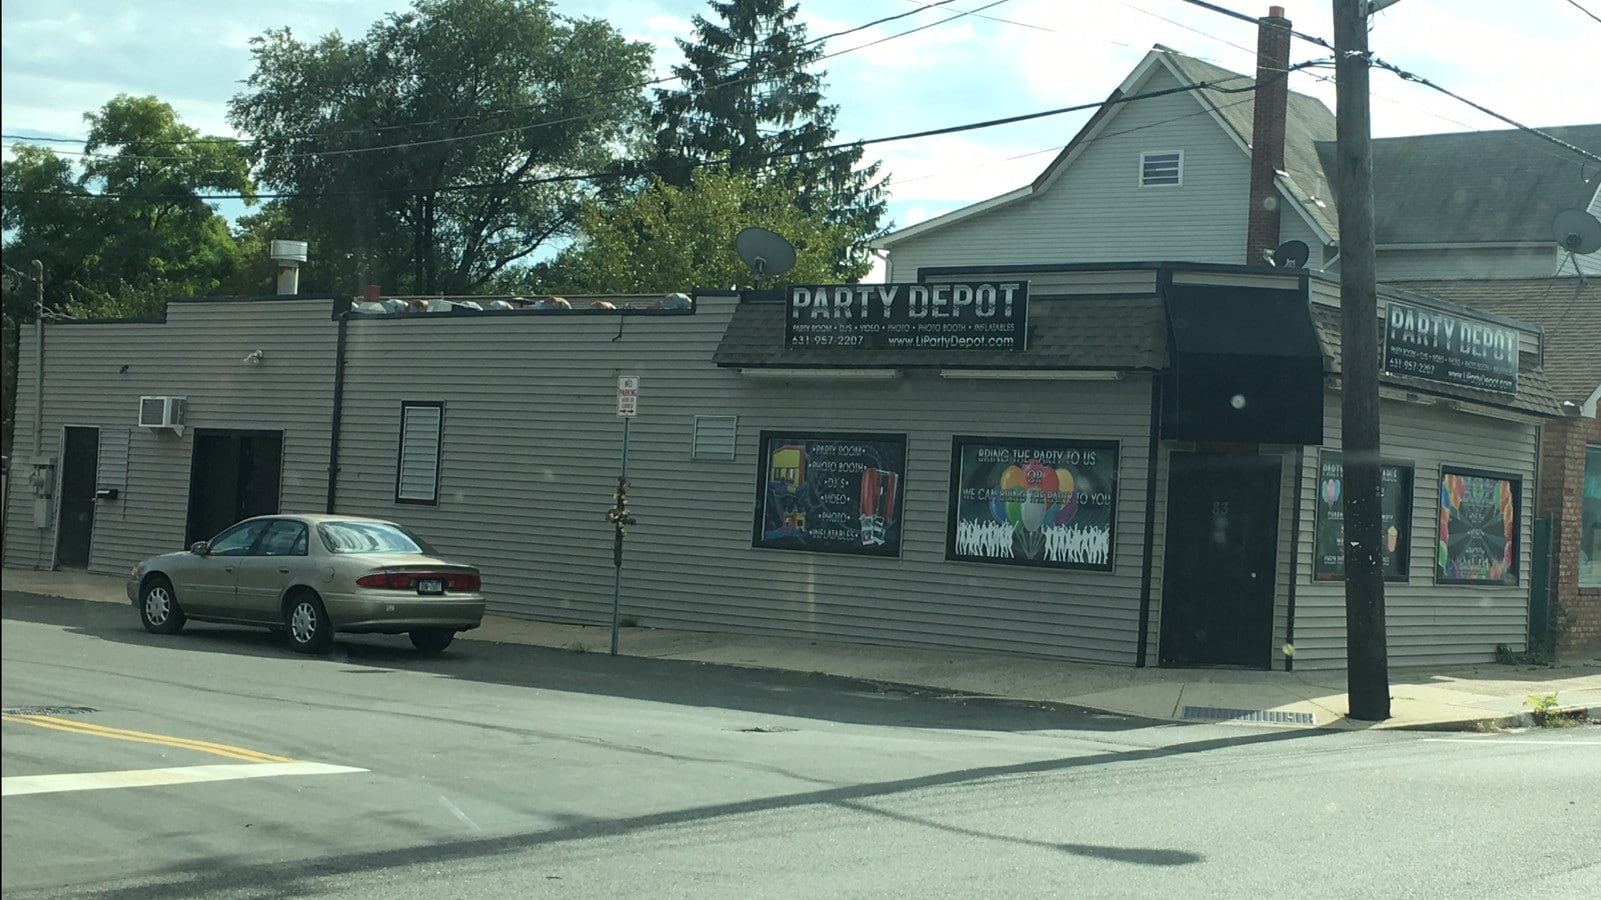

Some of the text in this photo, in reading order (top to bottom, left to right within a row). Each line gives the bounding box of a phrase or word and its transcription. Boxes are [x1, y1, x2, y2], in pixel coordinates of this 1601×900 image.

[792, 283, 1020, 319] PARTY DEPOT
[860, 324, 880, 332] VIDEO
[887, 324, 910, 332] PHOTO
[918, 324, 940, 332] PHOTO
[943, 323, 966, 332] BOOTH
[974, 323, 1015, 332] INFLATABLES
[1390, 306, 1515, 362] PARTY DEPOT
[792, 335, 1014, 348] 631-957-2207 www.LiPartyDepot.com
[816, 444, 862, 456] PARTY ROOM
[978, 449, 1096, 465] BRING THE PARTY TO US
[812, 461, 863, 473] PHOTO BOOTH
[1027, 469, 1043, 484] OR
[824, 493, 847, 505] VIDEO
[962, 487, 975, 500] WE
[978, 488, 998, 500] CAN
[1048, 491, 1073, 504] PARTY
[1076, 491, 1088, 505] TO
[1091, 492, 1111, 506] YOU
[822, 512, 847, 523] PHOTO
[812, 528, 855, 540] INFLATABLES
